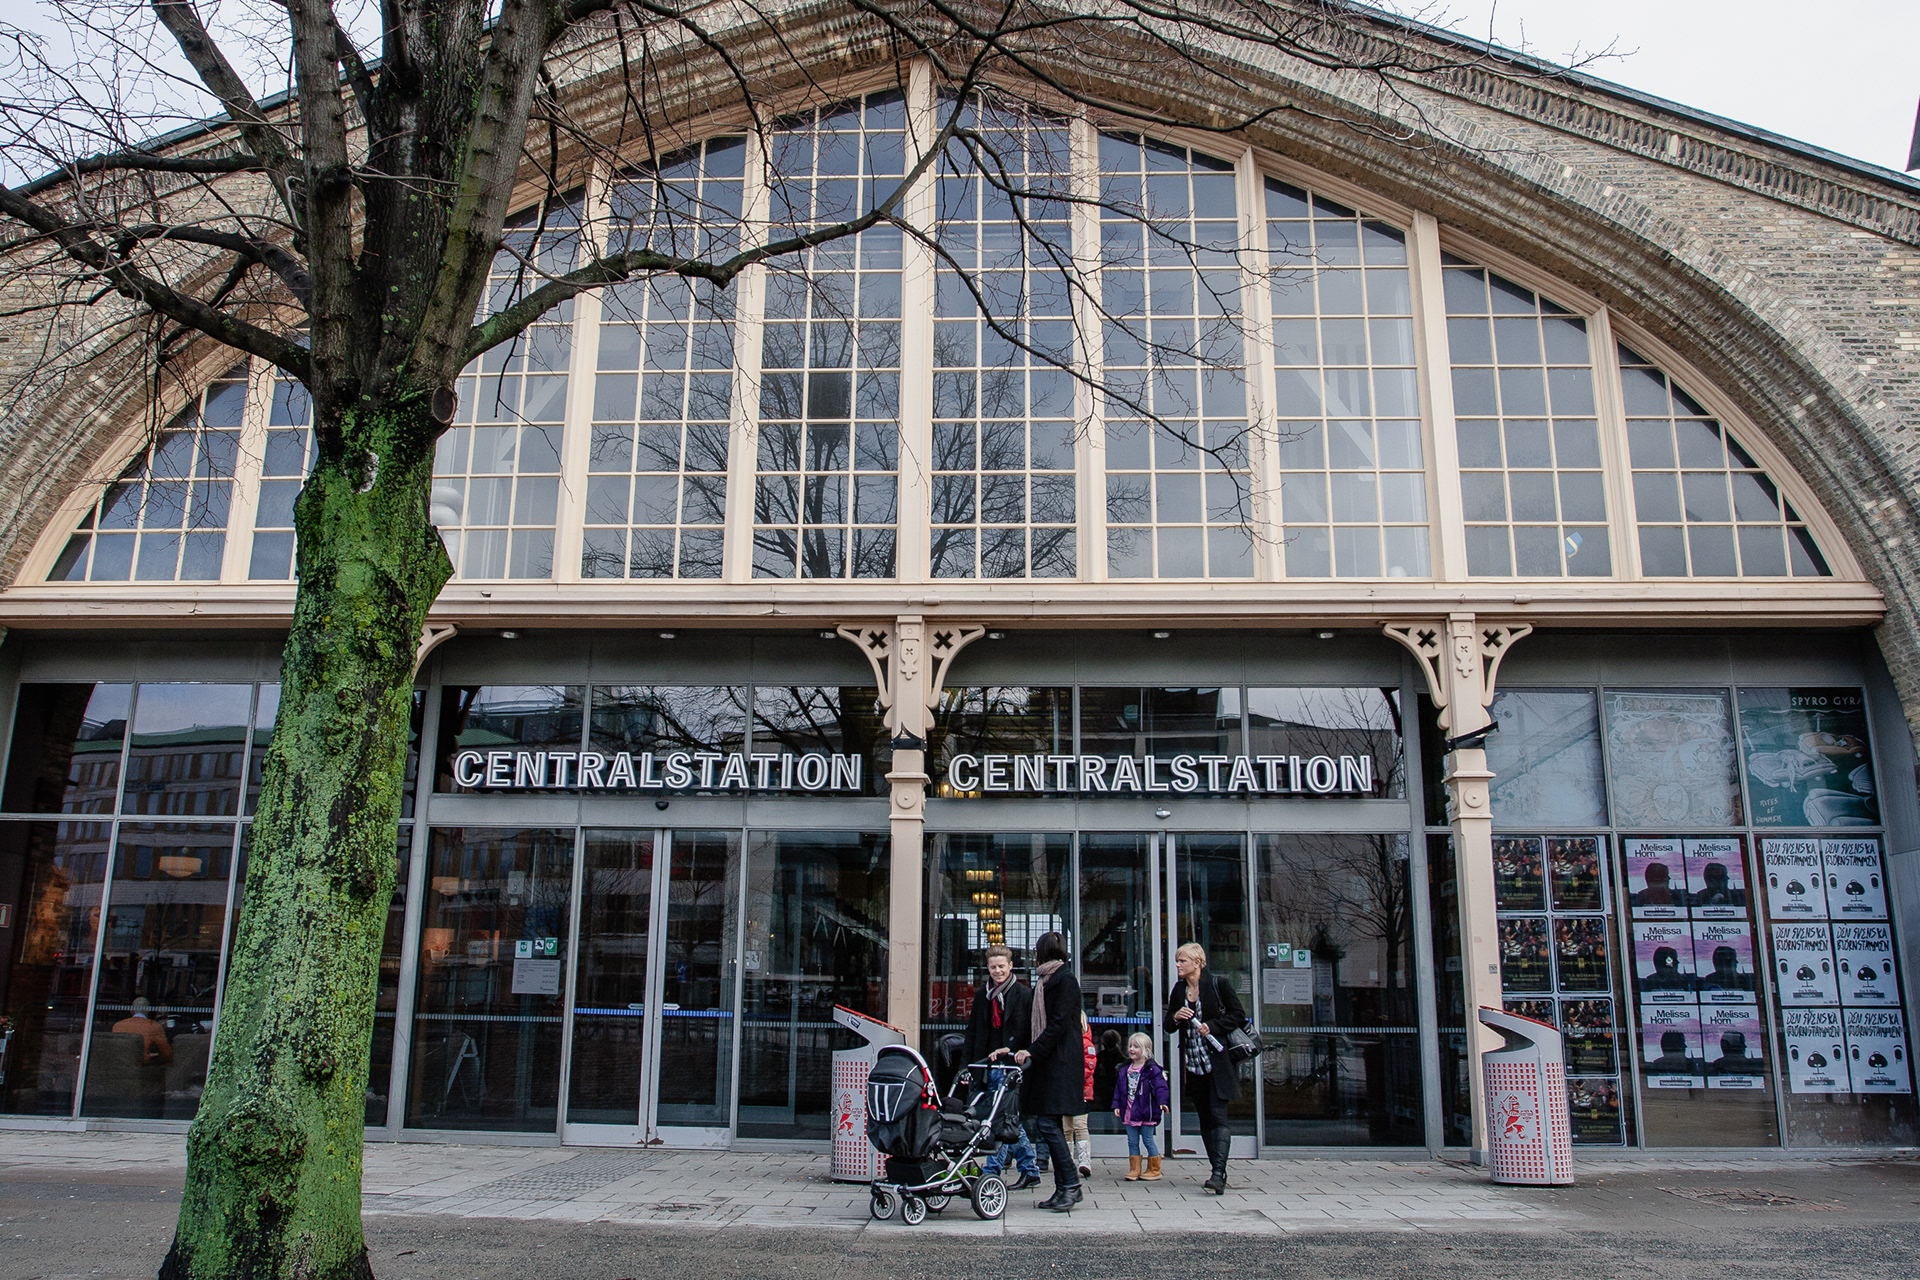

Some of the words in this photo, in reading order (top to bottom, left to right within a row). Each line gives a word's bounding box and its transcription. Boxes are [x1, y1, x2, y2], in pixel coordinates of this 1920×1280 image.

[1791, 696, 1828, 706] SPYRO
[454, 751, 862, 791] CENTRALSTATION
[948, 754, 1373, 793] CENTRALSTATION
[1766, 842, 1780, 854] DEN
[1782, 842, 1817, 854] SVENSKA
[1825, 842, 1839, 854] DEN
[1841, 842, 1876, 854] SVENSKA
[1635, 850, 1656, 858] Horn
[1693, 850, 1714, 858] Horn
[1649, 927, 1682, 935] Melissa
[1708, 926, 1741, 934] Melissa
[1776, 927, 1790, 939] DEN
[1792, 927, 1827, 939] SVENSKA
[1837, 927, 1851, 939] DEN
[1853, 927, 1888, 939] SVENSKA
[1643, 933, 1664, 941] Horn
[1702, 933, 1724, 941] Horn
[1656, 1010, 1690, 1018] Melissa
[1716, 1010, 1750, 1018] Melissa
[1650, 1016, 1672, 1024] Horn
[1710, 1017, 1732, 1025] Horn
[1787, 1012, 1801, 1024] DEN
[1803, 1012, 1839, 1025] SVENSKA
[1848, 1012, 1862, 1024] DEN
[1864, 1012, 1899, 1025] SVENSKA
